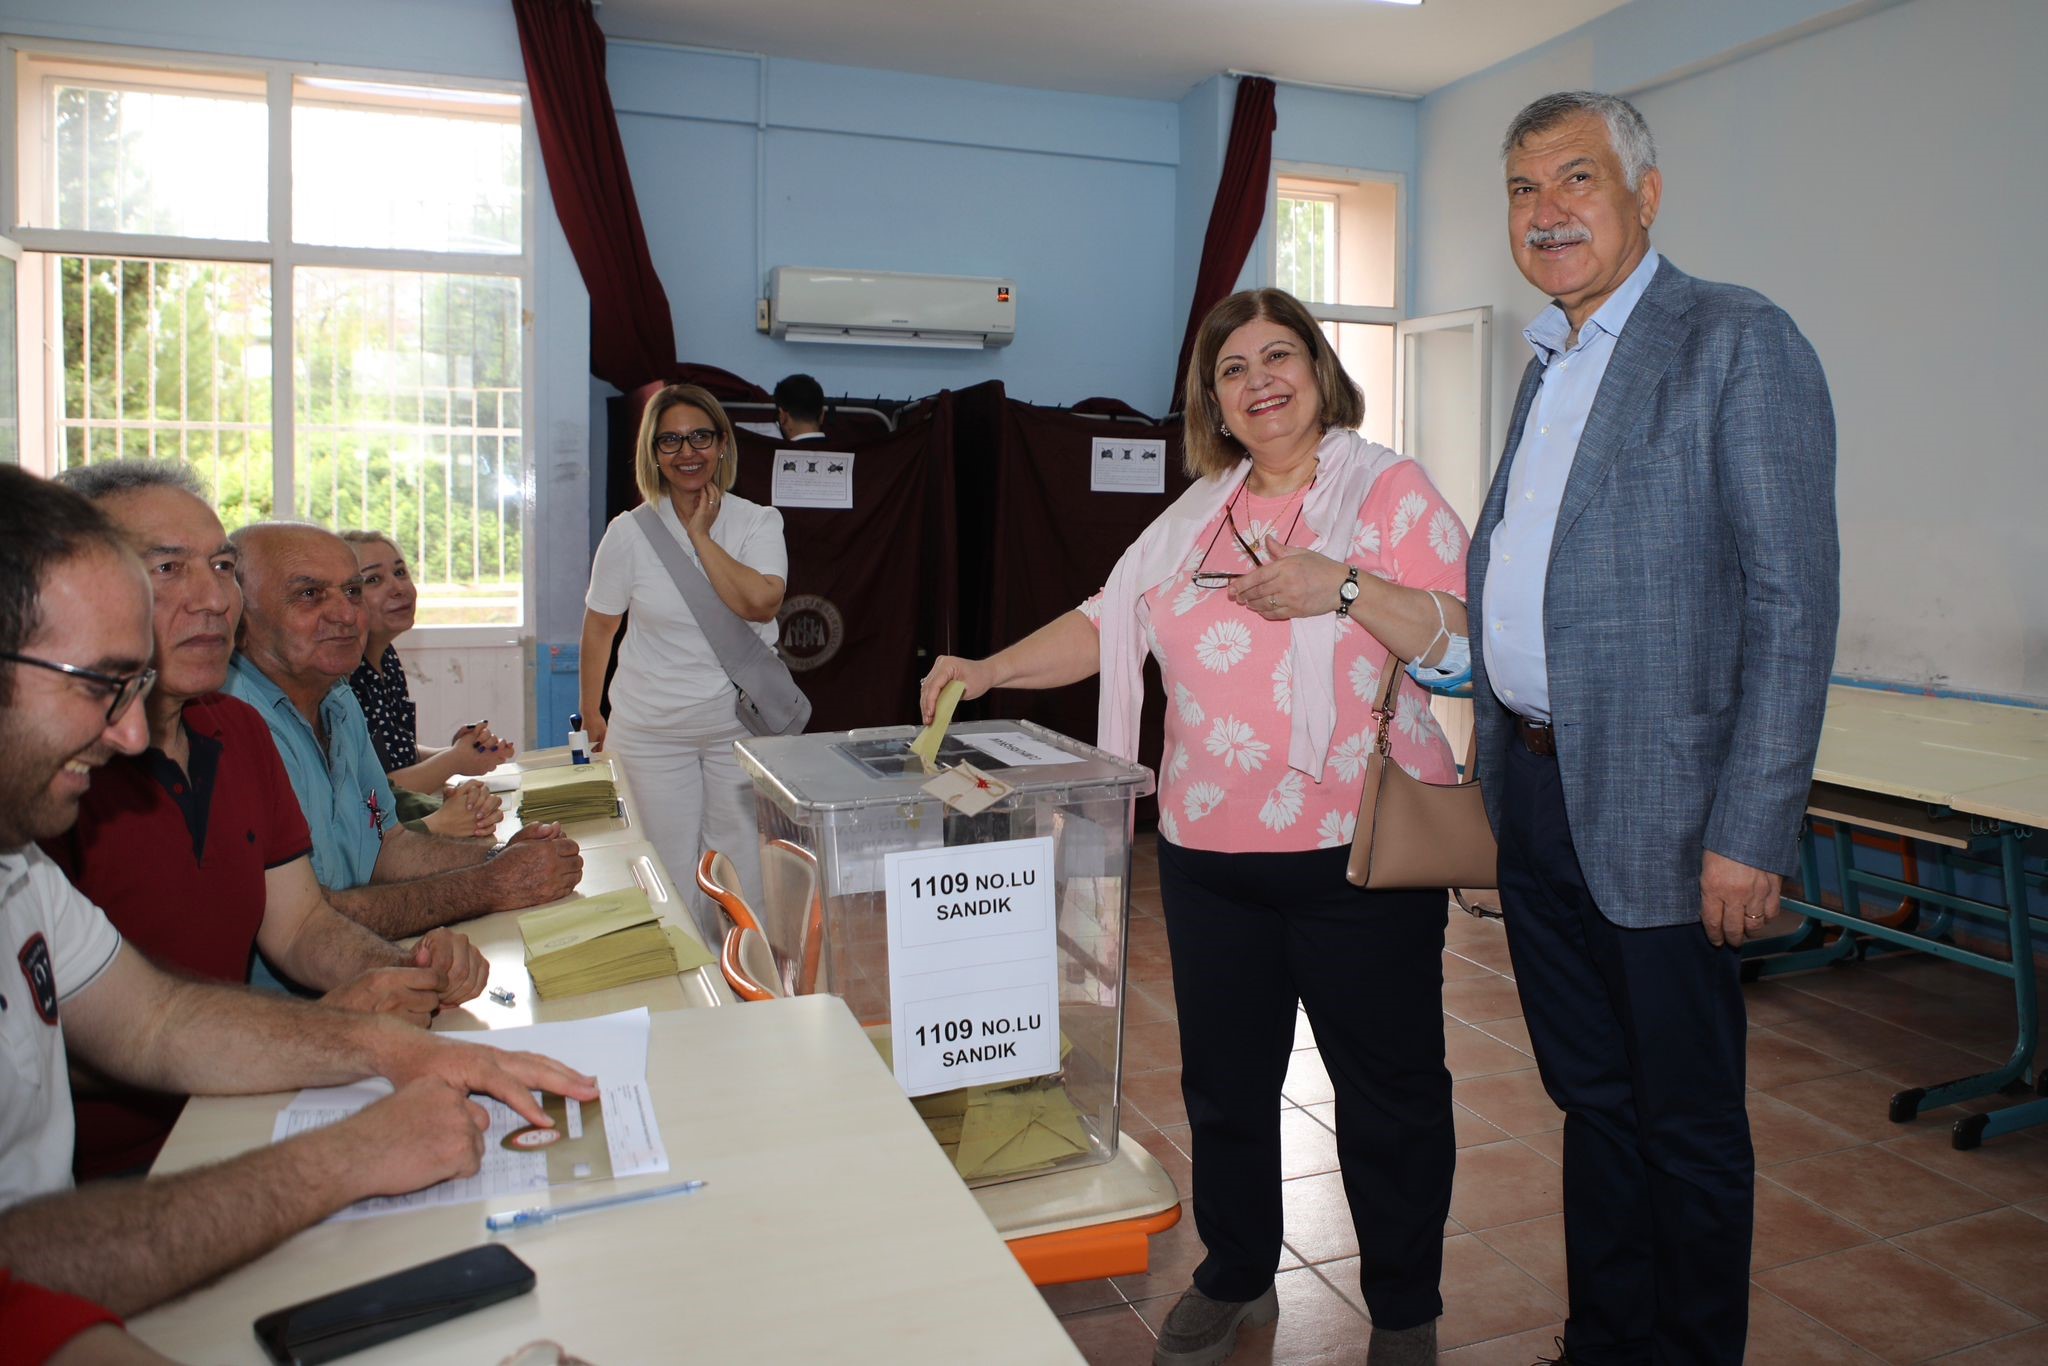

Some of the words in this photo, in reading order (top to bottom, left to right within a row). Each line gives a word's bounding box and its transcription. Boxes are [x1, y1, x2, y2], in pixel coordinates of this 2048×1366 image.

[910, 872, 969, 898] 1109
[976, 869, 1036, 890] NO.LU
[937, 897, 1012, 920] SANDIK
[915, 1018, 973, 1046] 1109
[981, 1014, 1042, 1036] NO.LU
[942, 1041, 1017, 1067] SANDIK
